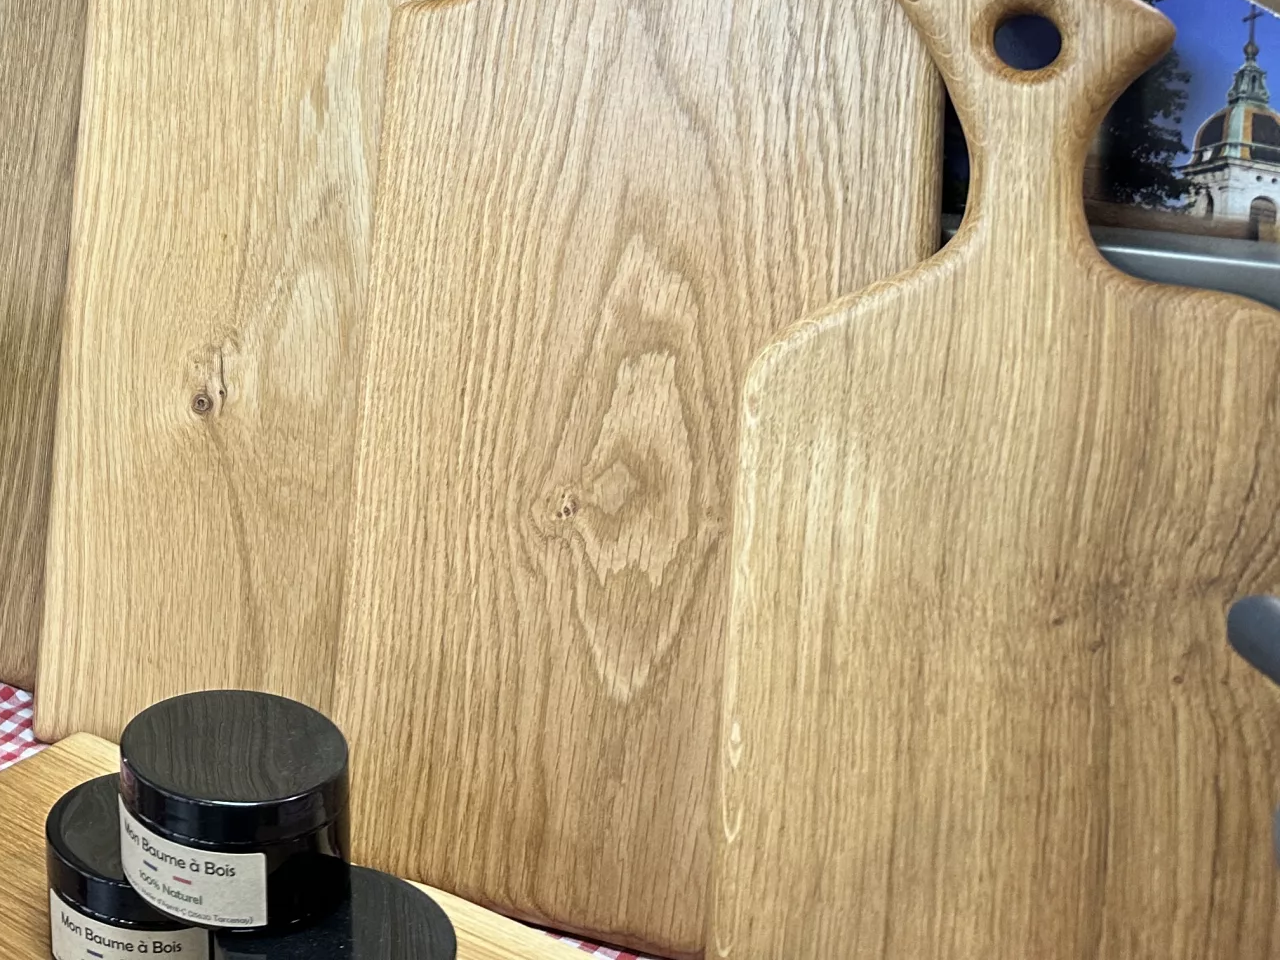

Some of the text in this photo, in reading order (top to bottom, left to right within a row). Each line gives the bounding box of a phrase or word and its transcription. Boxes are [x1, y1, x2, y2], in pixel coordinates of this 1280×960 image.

[124, 817, 236, 878] Mon Baume à Bois
[138, 869, 161, 891] 100%
[162, 883, 203, 906] Naturel
[61, 911, 182, 954] Mon Baume à Bois
